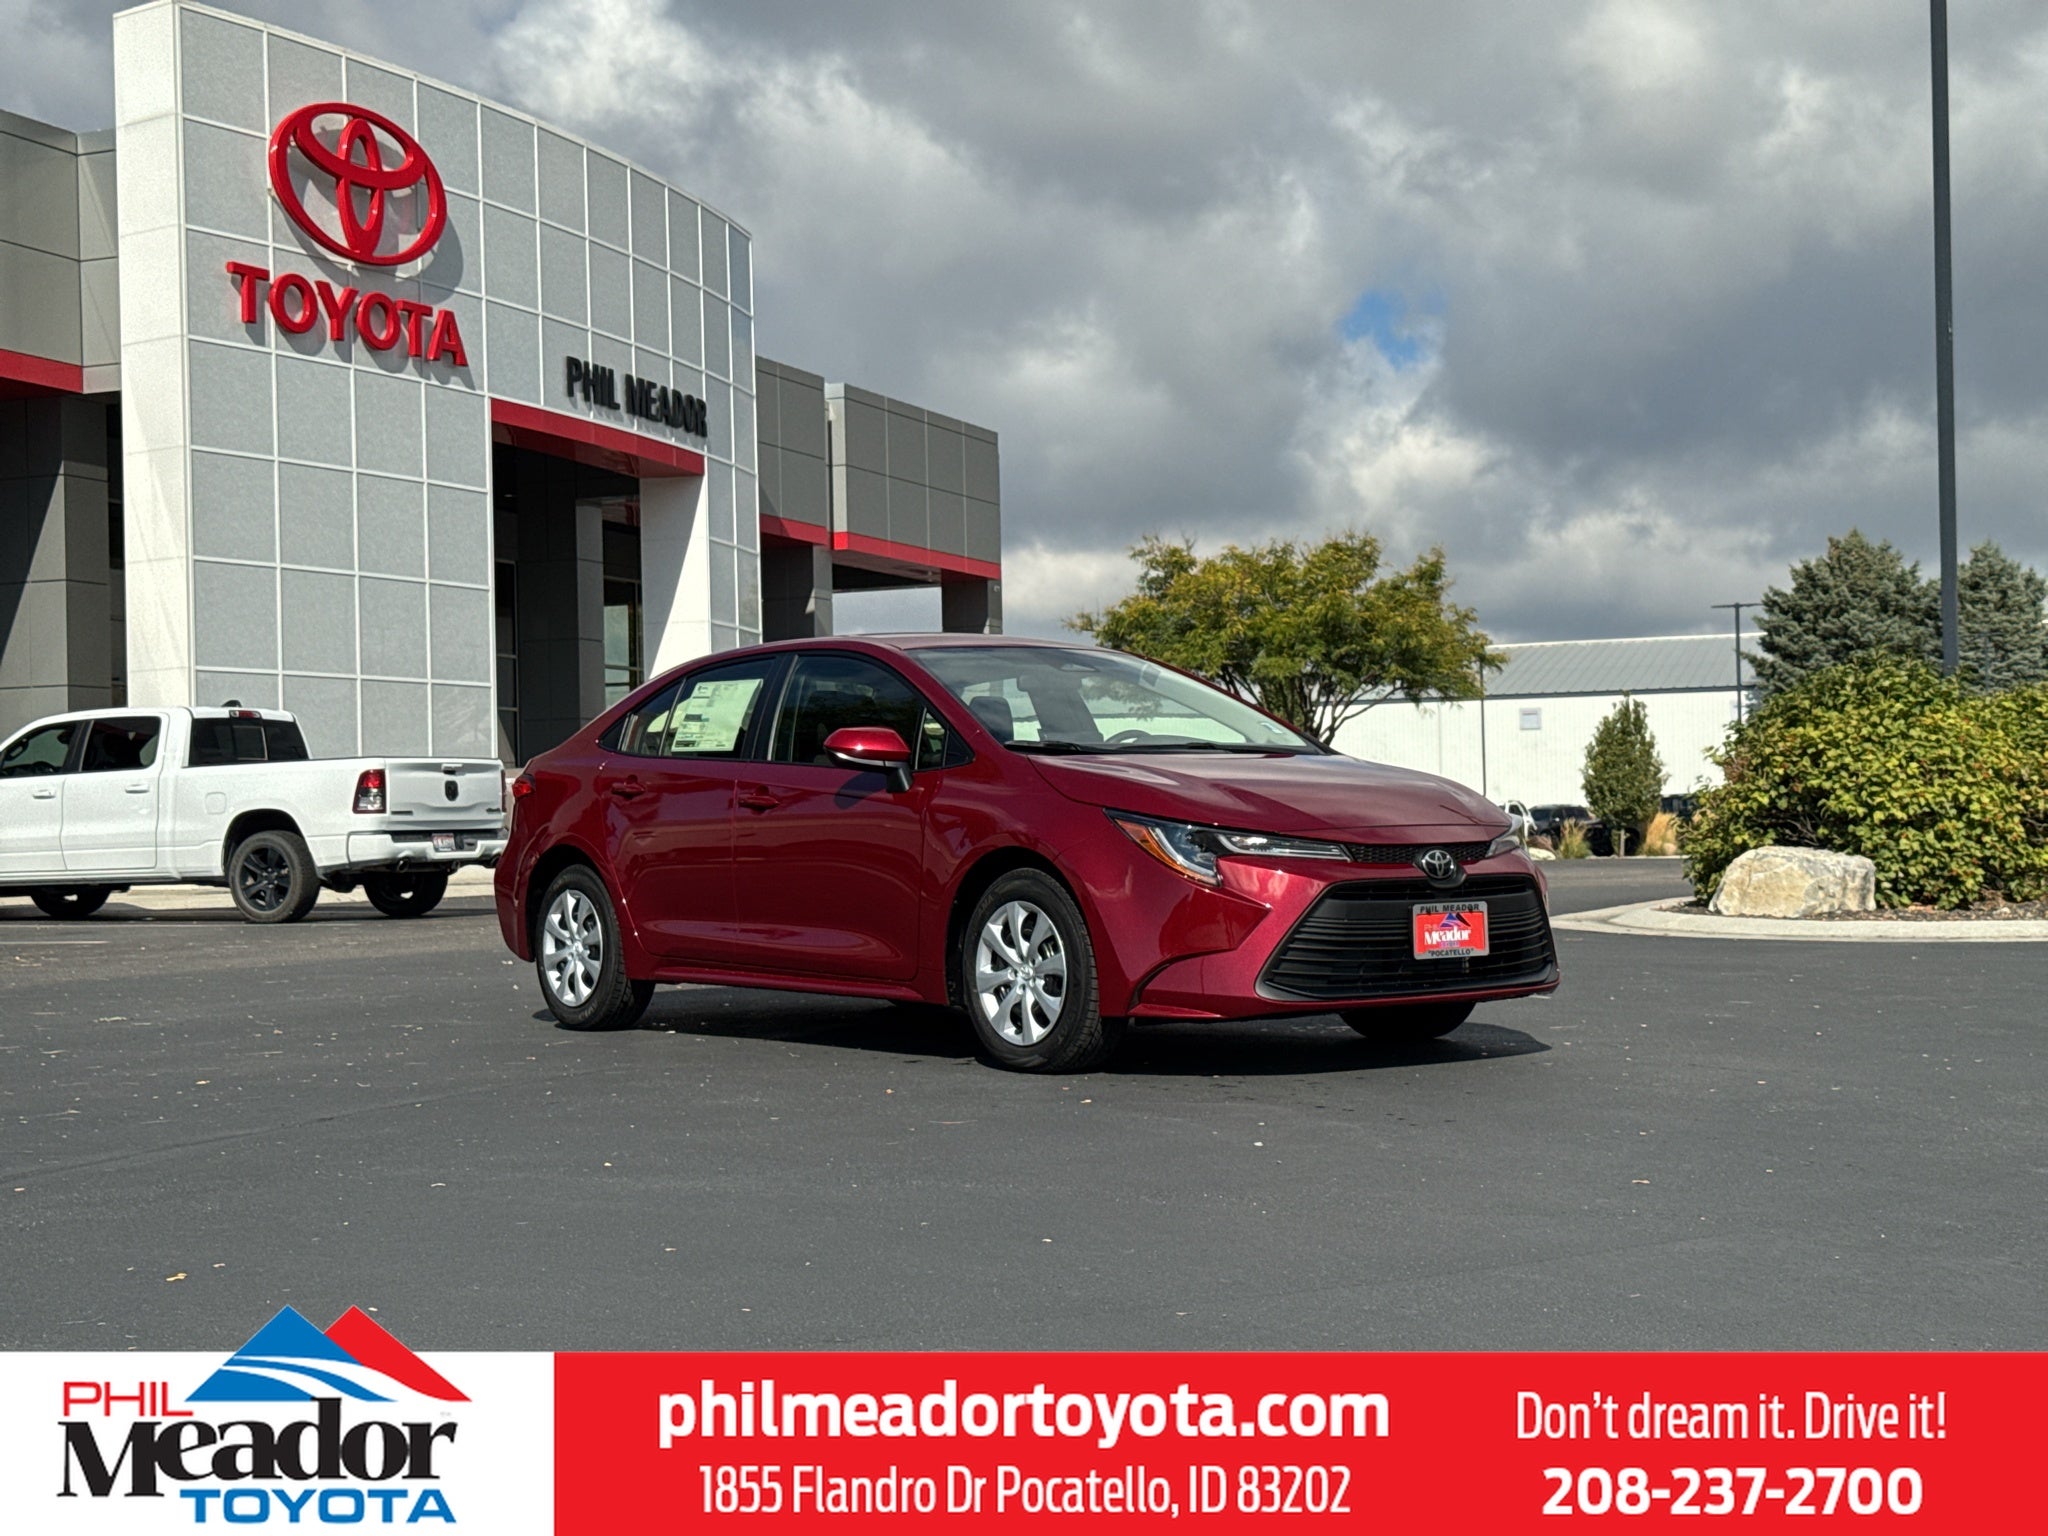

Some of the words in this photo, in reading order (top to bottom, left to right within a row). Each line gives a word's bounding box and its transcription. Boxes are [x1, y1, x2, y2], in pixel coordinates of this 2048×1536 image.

[227, 262, 467, 367] TOYOTA
[566, 356, 620, 410] PHIL
[625, 374, 708, 437] MEADOR
[1420, 905, 1439, 913] PHIL
[1442, 903, 1480, 912] MEADOR
[1424, 925, 1472, 945] Meador
